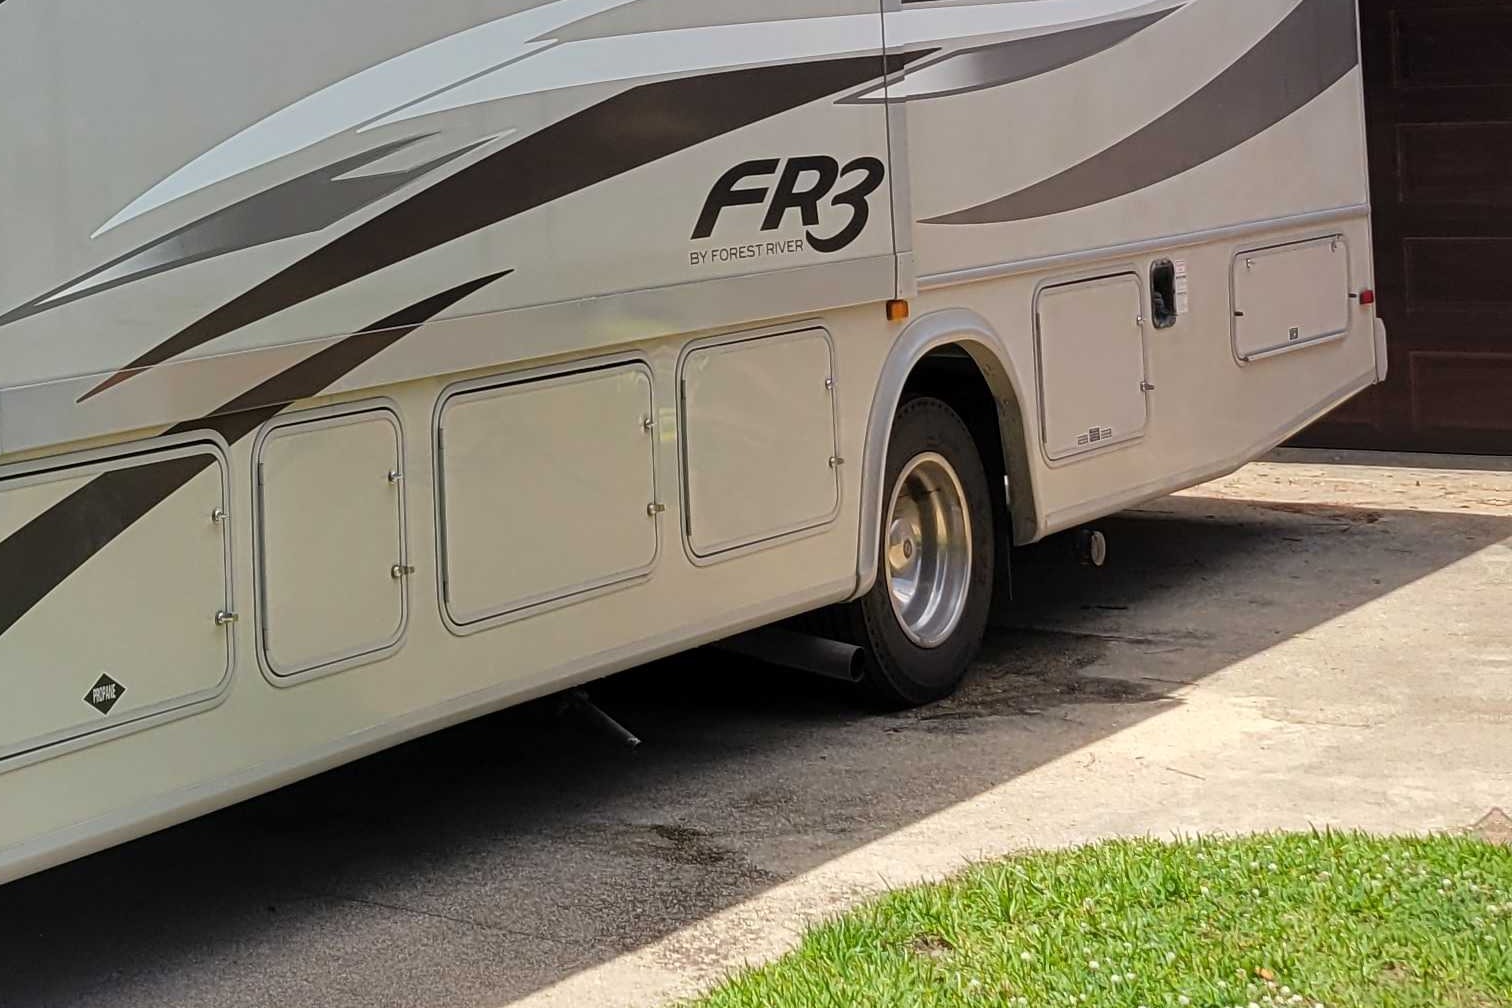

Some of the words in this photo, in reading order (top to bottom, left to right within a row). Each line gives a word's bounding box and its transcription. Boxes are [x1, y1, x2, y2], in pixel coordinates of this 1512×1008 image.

[690, 155, 885, 253] FR3
[690, 251, 707, 265] BY
[711, 244, 764, 262] FOREST
[766, 239, 804, 256] RIVER
